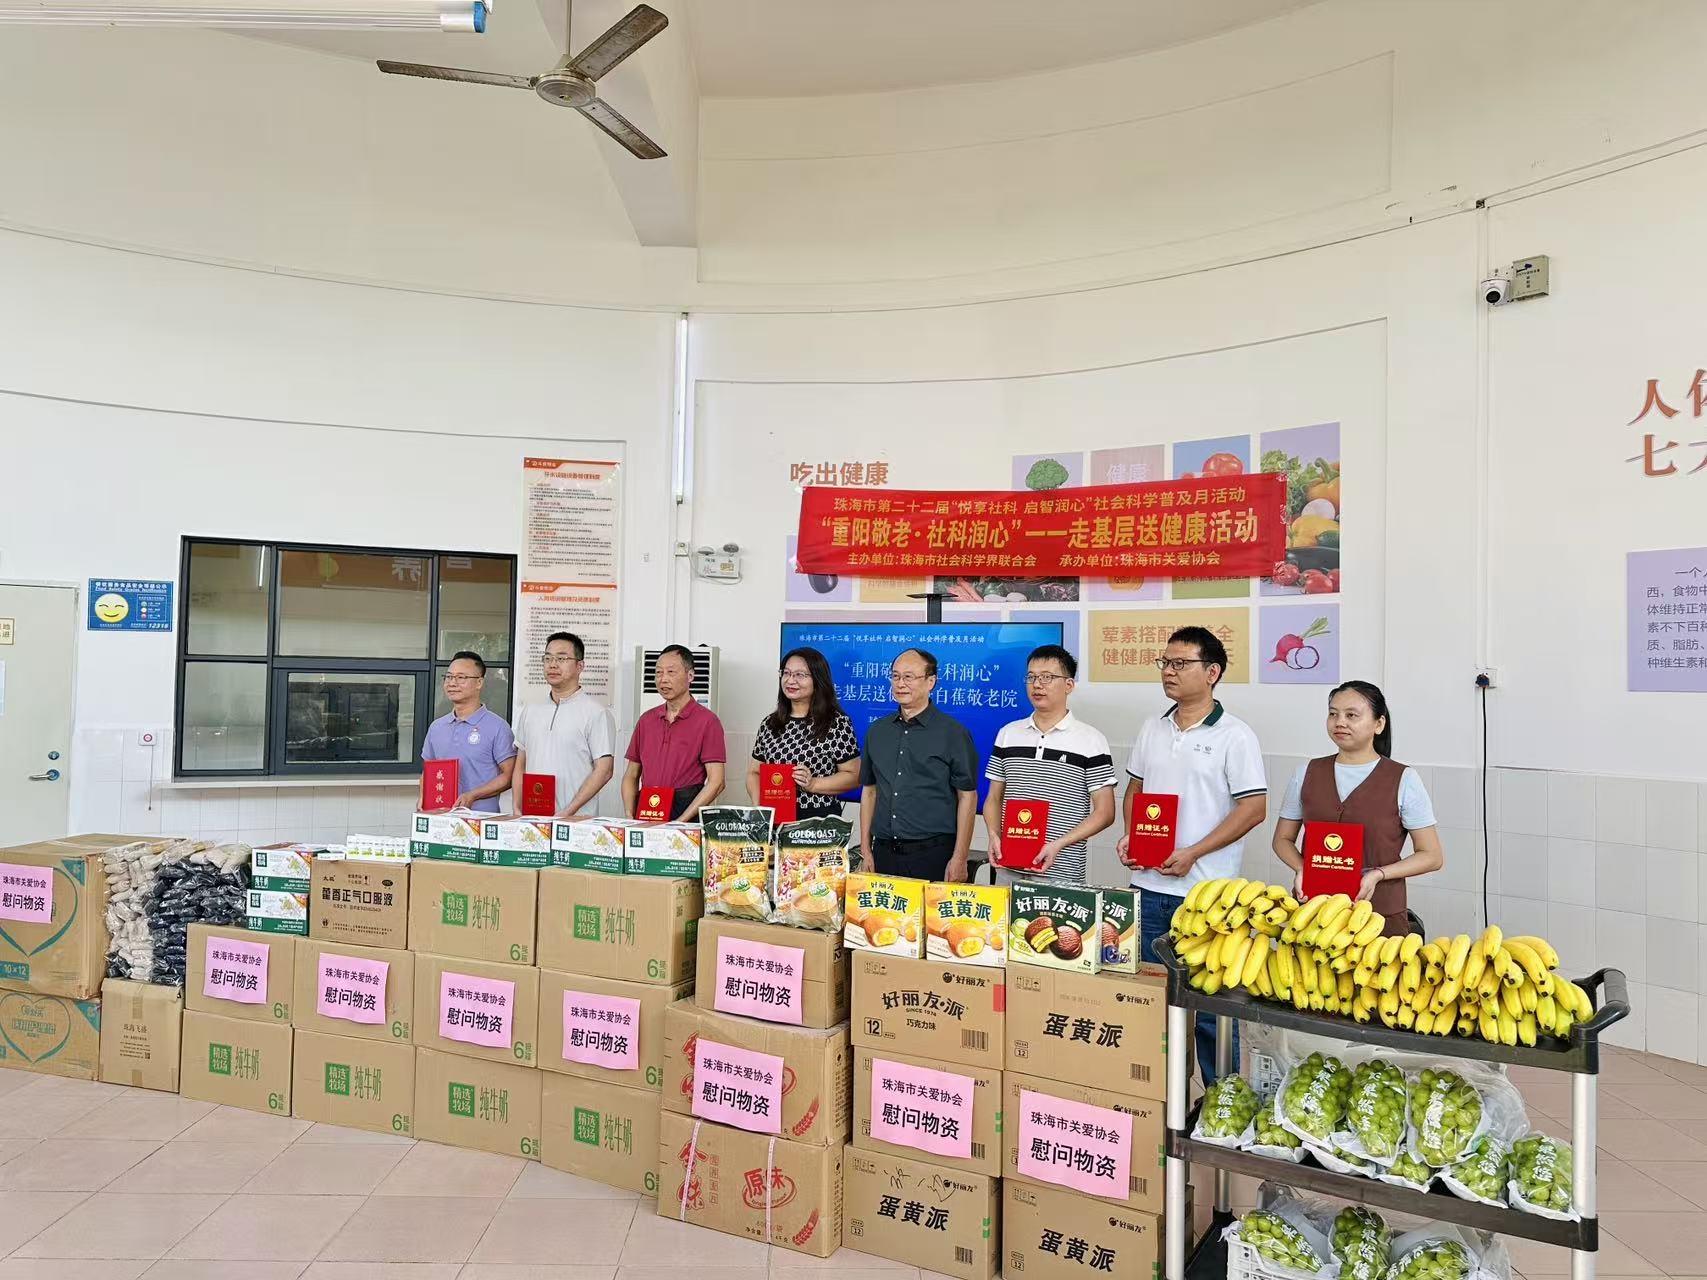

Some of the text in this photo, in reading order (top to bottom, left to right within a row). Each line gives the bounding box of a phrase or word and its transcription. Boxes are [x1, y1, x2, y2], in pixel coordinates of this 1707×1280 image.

[790, 461, 889, 486] 吃出健康
[848, 551, 1221, 567] 主办单位:珠海市社会科学界联合会 承办单位:珠海市关爱协会
[1102, 624, 1235, 644] 荤素搭配全
[1007, 827, 1039, 835] 捐赠证书
[1136, 823, 1169, 833] 捐赠证书
[1312, 854, 1354, 866] 捐赠证书
[870, 881, 894, 891] 好丽友
[951, 890, 976, 899] 好丽友
[857, 891, 908, 914] 蛋黄派
[938, 899, 992, 922] 蛋黄派
[1015, 896, 1090, 923] 好丽友·派
[472, 896, 501, 932] 纯牛奶
[605, 908, 635, 945] 纯牛奶
[212, 950, 262, 967] 珠海市关爱协会
[510, 943, 521, 961] 6
[647, 959, 659, 978] 6
[725, 954, 794, 976] 珠海市关爱协会
[211, 968, 258, 991] 慰问物资
[325, 967, 380, 986] 珠海市关爱协会
[955, 975, 986, 988] 好丽友
[325, 986, 377, 1011] 慰问物资
[448, 987, 507, 1006] 珠海市关爱协会
[725, 977, 791, 1007] 慰问物资
[273, 1002, 283, 1018] 6
[881, 989, 966, 1021] 好丽友·派
[447, 1007, 503, 1034] 慰问物资
[570, 1006, 632, 1026] 珠海市关爱协会
[906, 1018, 936, 1031] 巧克力味
[392, 1021, 402, 1038] 6
[866, 1020, 880, 1035] 12
[1043, 1012, 1124, 1048] 蛋黄派
[513, 1041, 524, 1059] 6
[570, 1028, 628, 1055] 慰问物资
[1017, 1049, 1026, 1057] 12
[235, 1046, 260, 1081] 纯牛奶
[703, 1058, 774, 1086] 珠海市关爱协会
[355, 1066, 382, 1101] 纯牛奶
[646, 1066, 657, 1085] 6
[268, 1092, 278, 1109] 6
[702, 1081, 770, 1117] 慰问物资
[882, 1078, 963, 1107] 珠海市关爱协会
[479, 1087, 508, 1124] 纯牛奶
[392, 1113, 402, 1131] 6
[882, 1103, 960, 1140] 慰问物资
[1031, 1111, 1121, 1145] 珠海市关爱协会
[604, 1113, 632, 1155] 纯牛奶
[520, 1137, 531, 1155] 6
[1030, 1138, 1117, 1180] 慰问物资
[644, 1171, 655, 1191] 6
[877, 1194, 949, 1231] 蛋黄派
[854, 1227, 862, 1235] 12
[1038, 1228, 1116, 1272] 蛋黄派
[1014, 1261, 1022, 1269] 12
